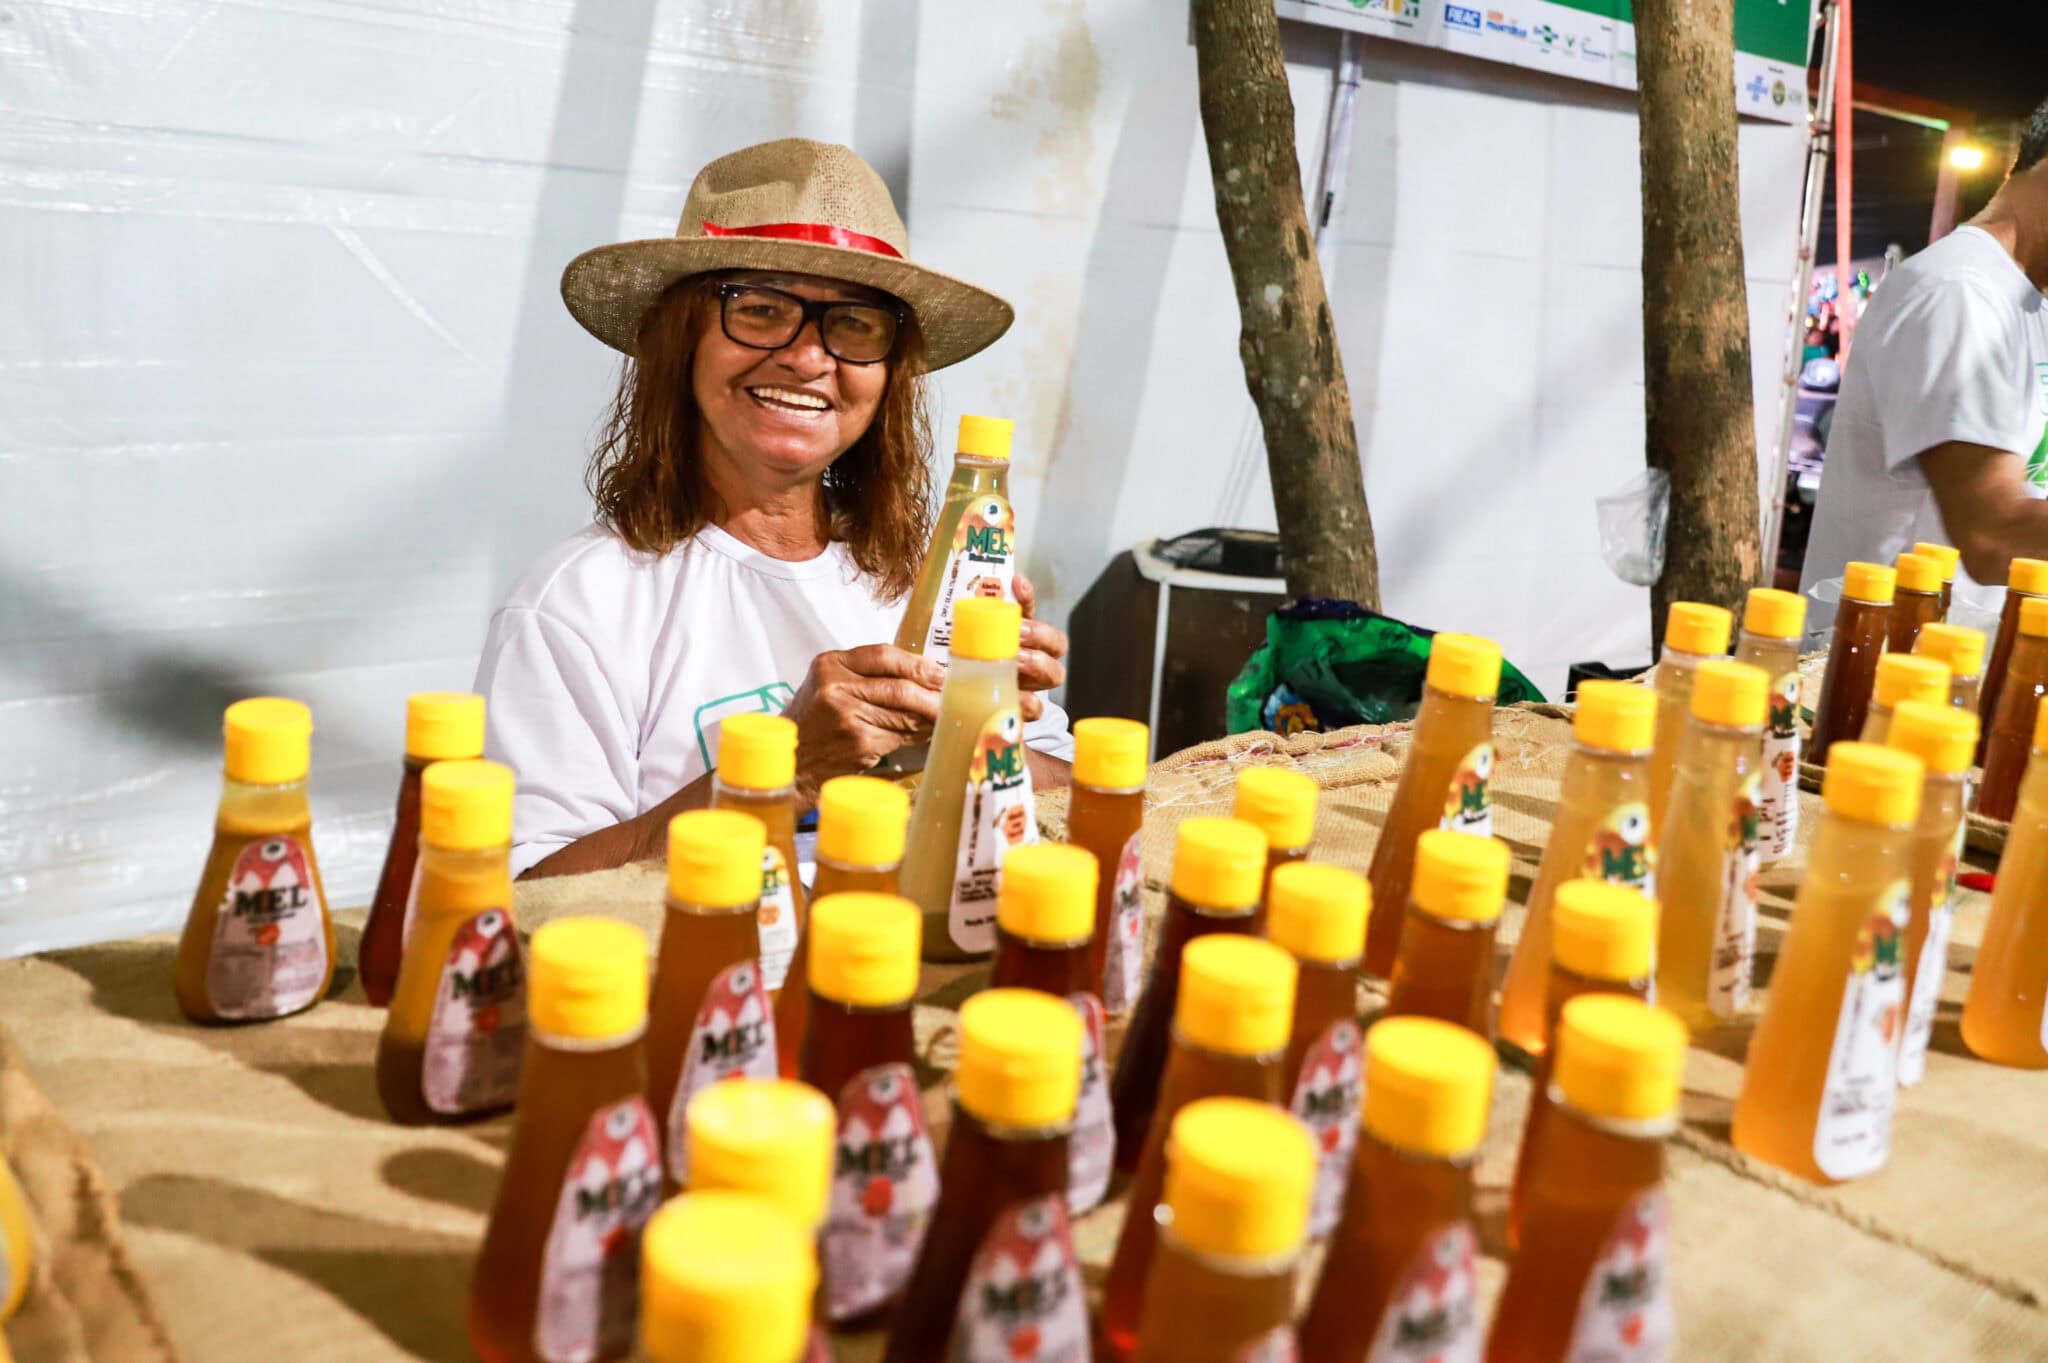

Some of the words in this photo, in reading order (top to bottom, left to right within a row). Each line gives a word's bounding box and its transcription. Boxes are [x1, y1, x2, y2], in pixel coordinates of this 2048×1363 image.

[966, 525, 1007, 556] MEL
[233, 884, 308, 917] MEL
[701, 1019, 766, 1063] MEL
